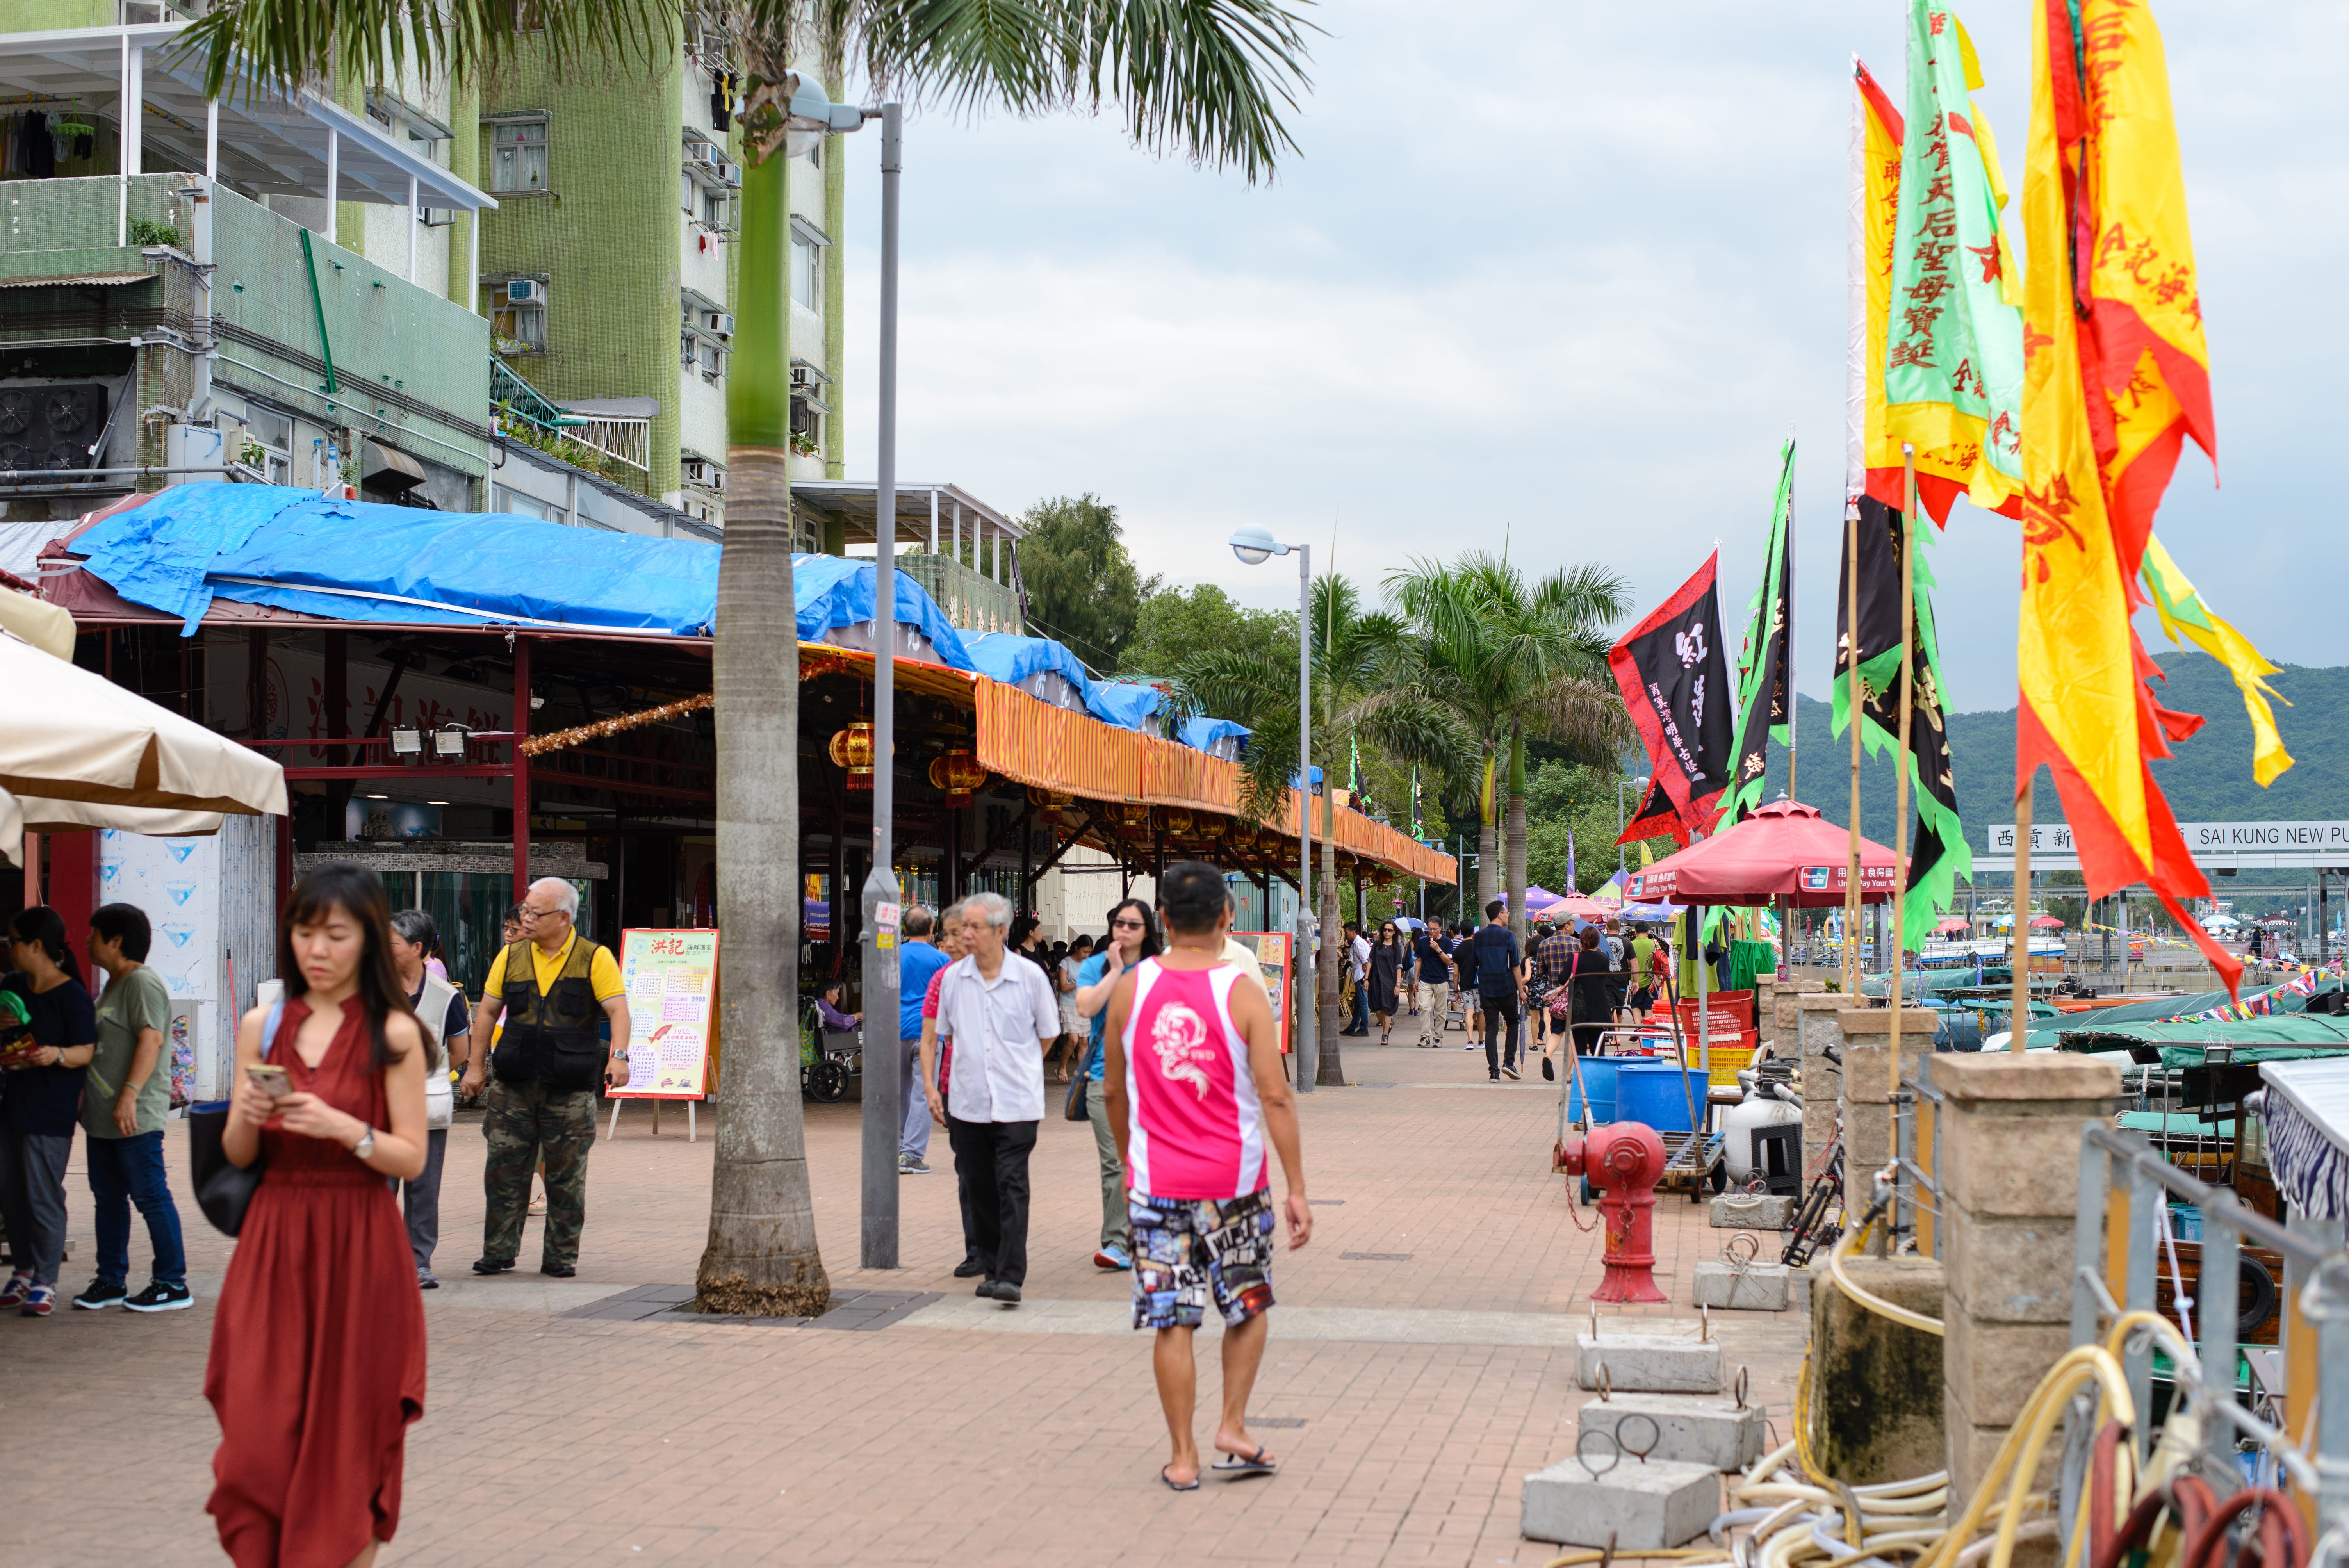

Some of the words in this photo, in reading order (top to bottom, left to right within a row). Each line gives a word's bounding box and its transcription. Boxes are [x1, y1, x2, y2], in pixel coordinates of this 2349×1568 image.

[2200, 829, 2225, 844] SAI
[2233, 828, 2279, 844] KUNG
[2287, 827, 2324, 843] NEW
[651, 938, 685, 955] 洪記
